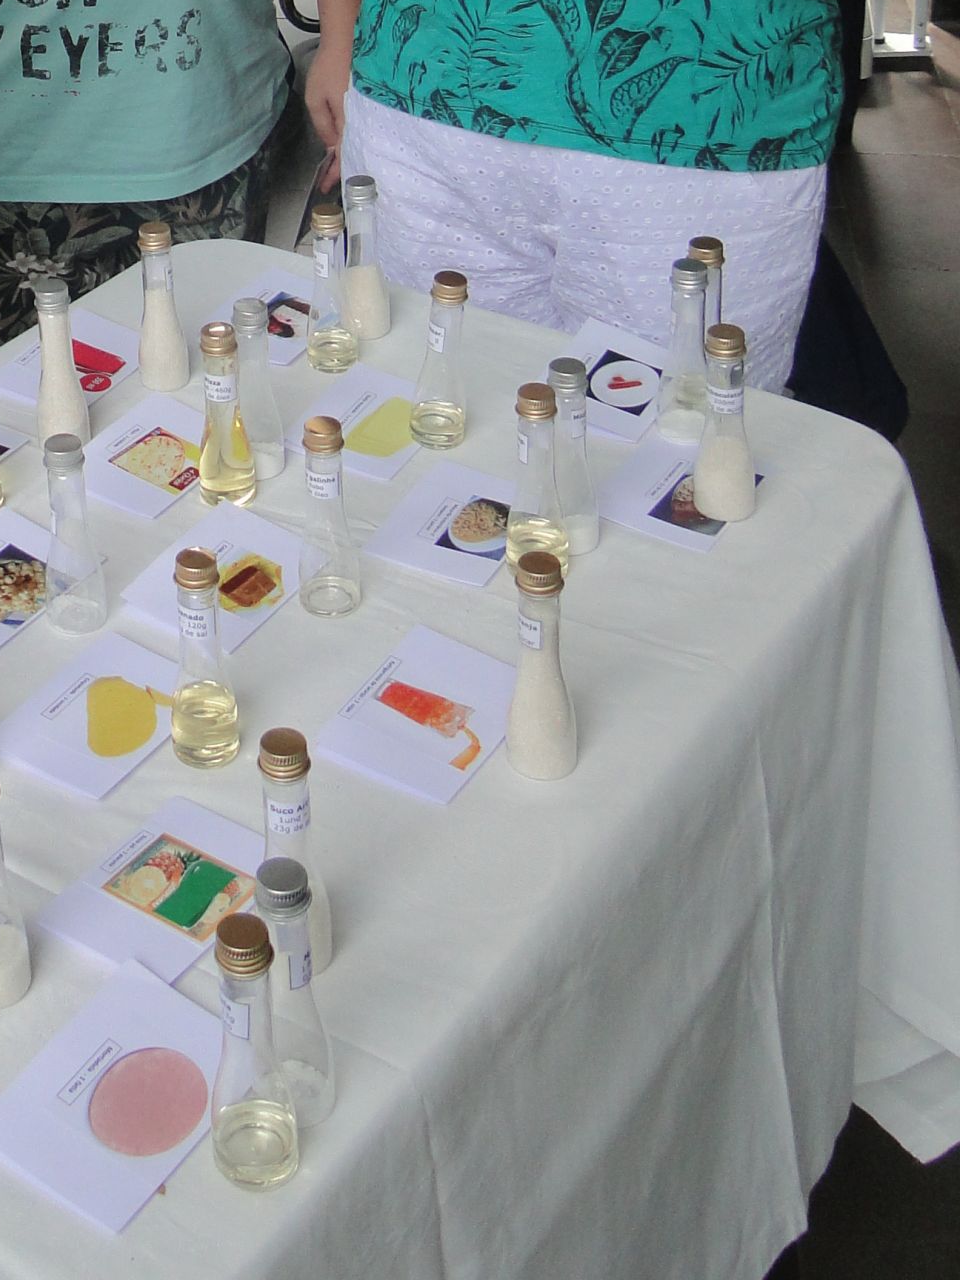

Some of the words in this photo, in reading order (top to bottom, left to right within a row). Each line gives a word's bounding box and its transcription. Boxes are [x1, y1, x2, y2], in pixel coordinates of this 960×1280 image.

[188, 620, 207, 630] 120g
[270, 804, 294, 815] Suco
[273, 823, 291, 834] 23g
[86, 1044, 114, 1074] Mortadela
